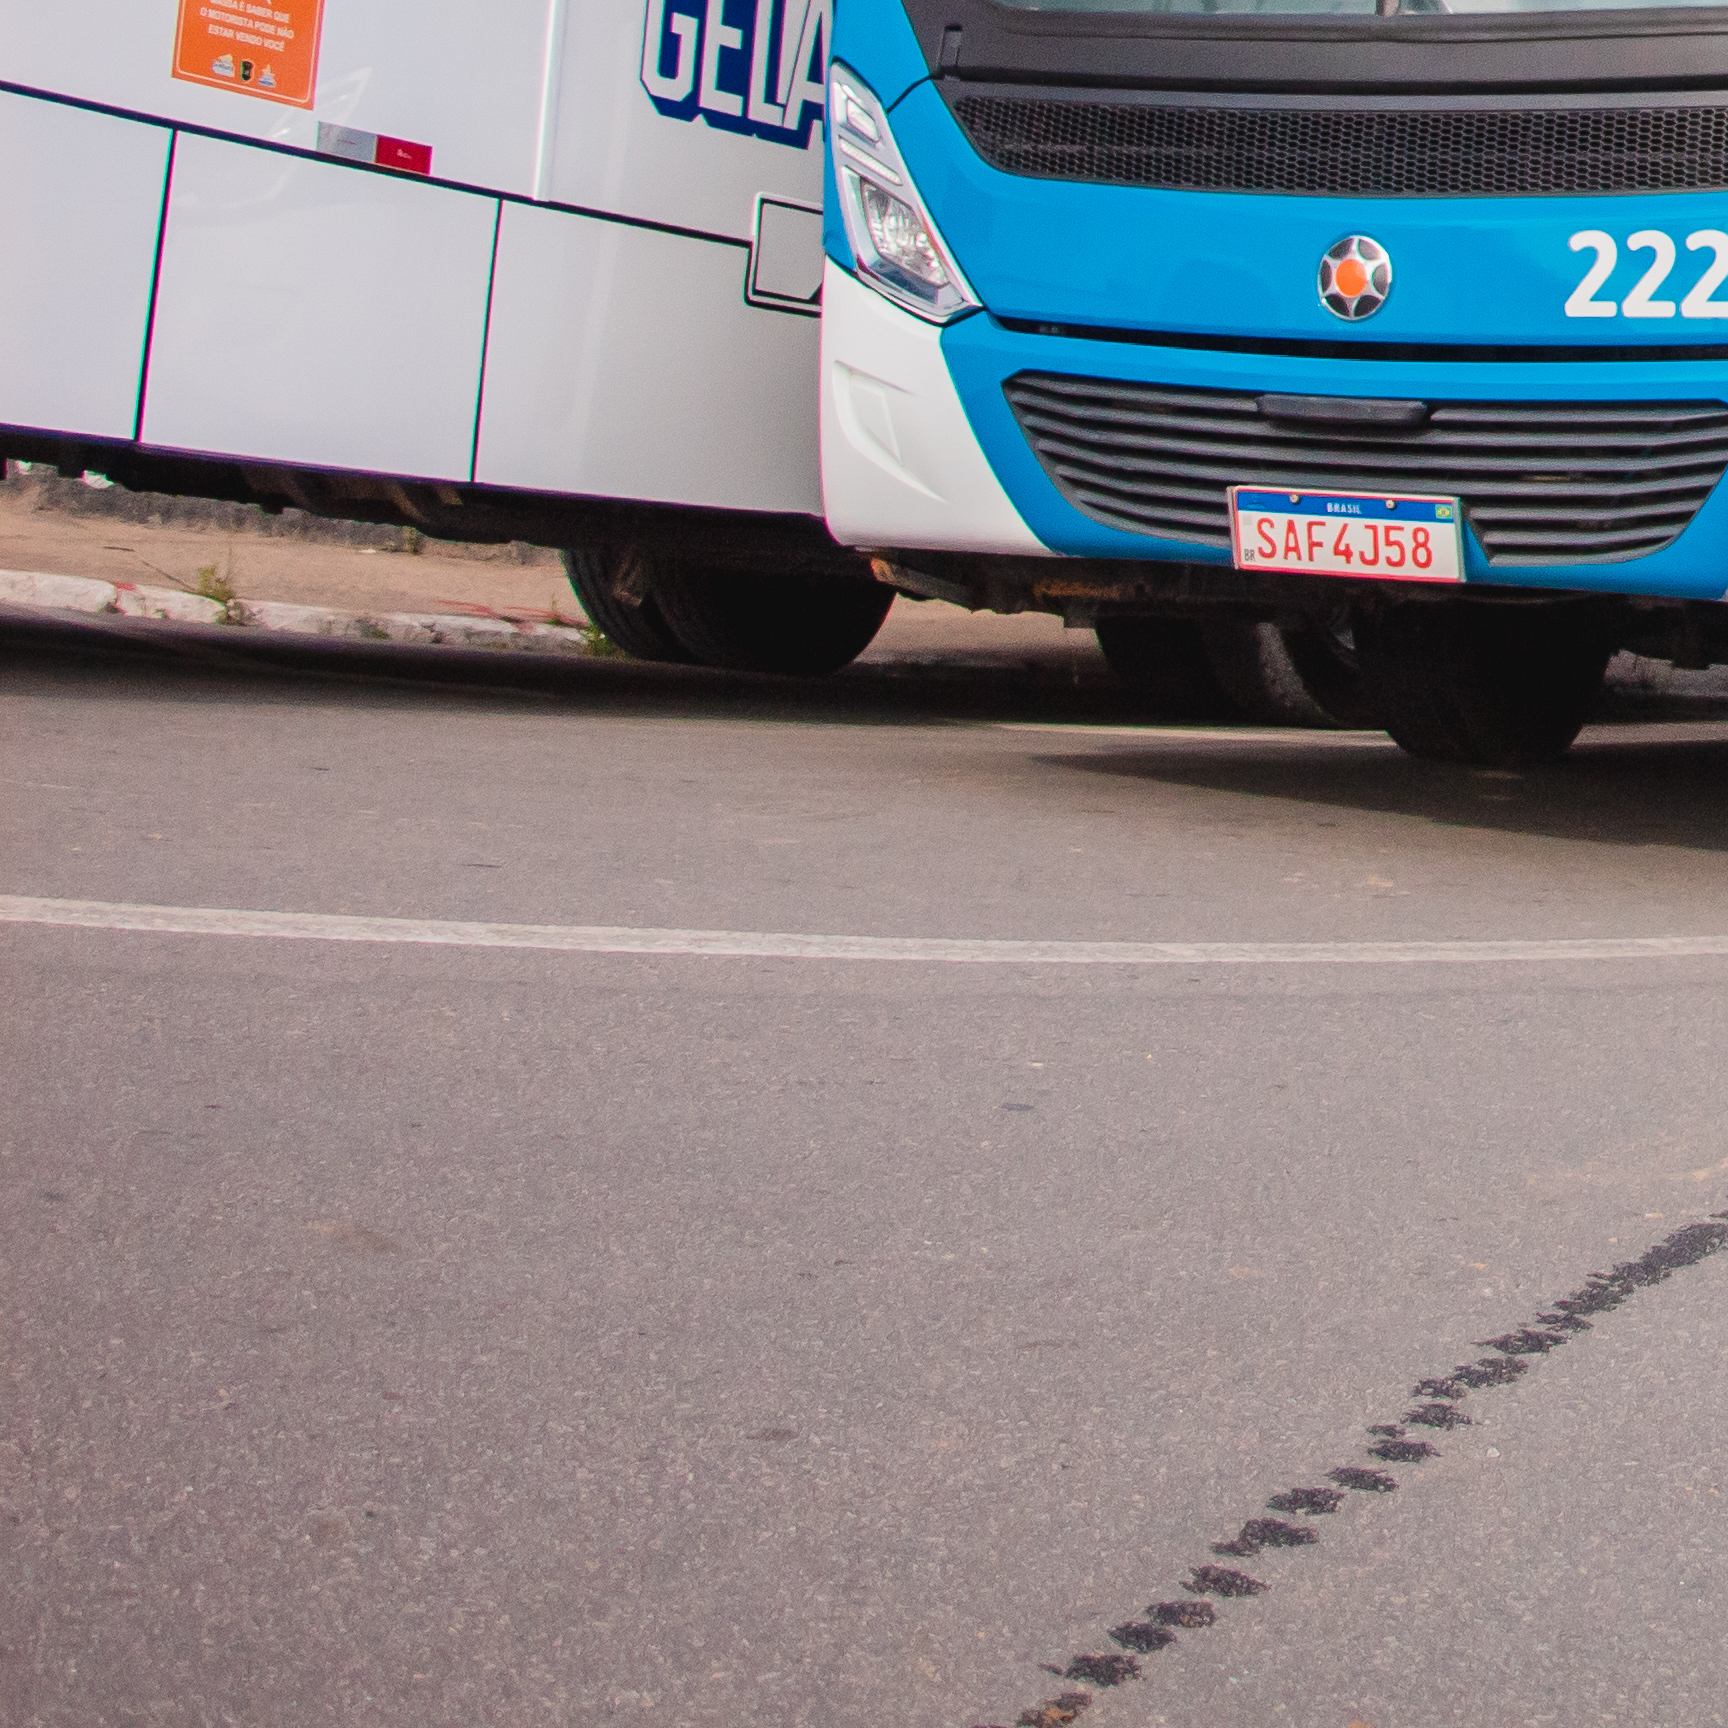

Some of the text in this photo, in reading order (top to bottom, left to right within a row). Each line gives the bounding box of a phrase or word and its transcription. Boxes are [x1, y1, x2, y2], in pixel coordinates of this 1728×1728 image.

[199, 6, 208, 17] O
[207, 8, 254, 29] MOTORISTA
[276, 25, 295, 40] NÃO
[1326, 502, 1362, 515] BRASIL
[1243, 548, 1256, 562] BR
[1256, 517, 1433, 569] SAF4J58
